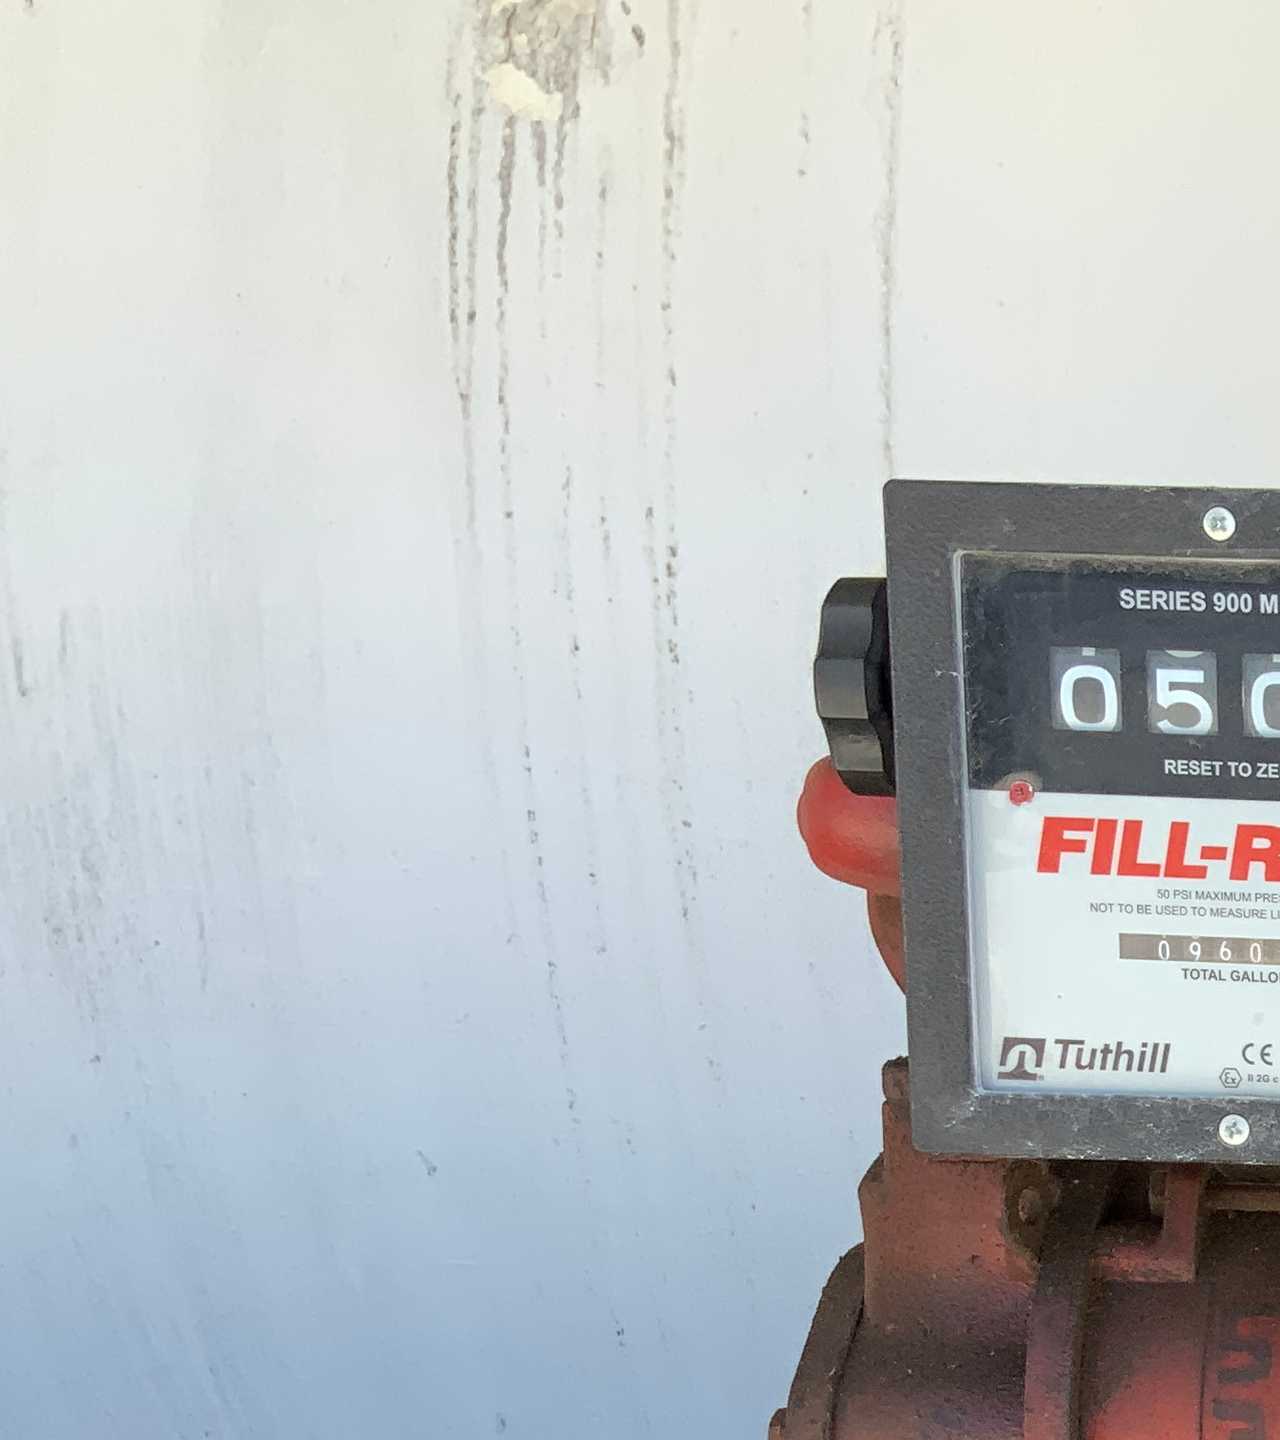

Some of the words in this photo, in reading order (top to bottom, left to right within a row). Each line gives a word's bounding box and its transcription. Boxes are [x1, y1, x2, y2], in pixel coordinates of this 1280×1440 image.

[1119, 589, 1207, 613] SERIES
[1212, 591, 1253, 615] 900
[1163, 759, 1224, 778] RESET
[1227, 760, 1253, 779] TO
[1157, 889, 1170, 900] 50
[1173, 889, 1192, 901] PSI
[1194, 890, 1252, 903] MAXIMUM
[1089, 902, 1114, 913] NOT
[1117, 903, 1134, 914] TO
[1136, 904, 1152, 915] BE
[1155, 905, 1187, 916] USED
[1190, 906, 1207, 917] TO
[1209, 907, 1267, 920] MEASURE
[1181, 968, 1226, 982] TOTAL
[1054, 1038, 1171, 1073] Tuthill
[1242, 1043, 1273, 1066] CE
